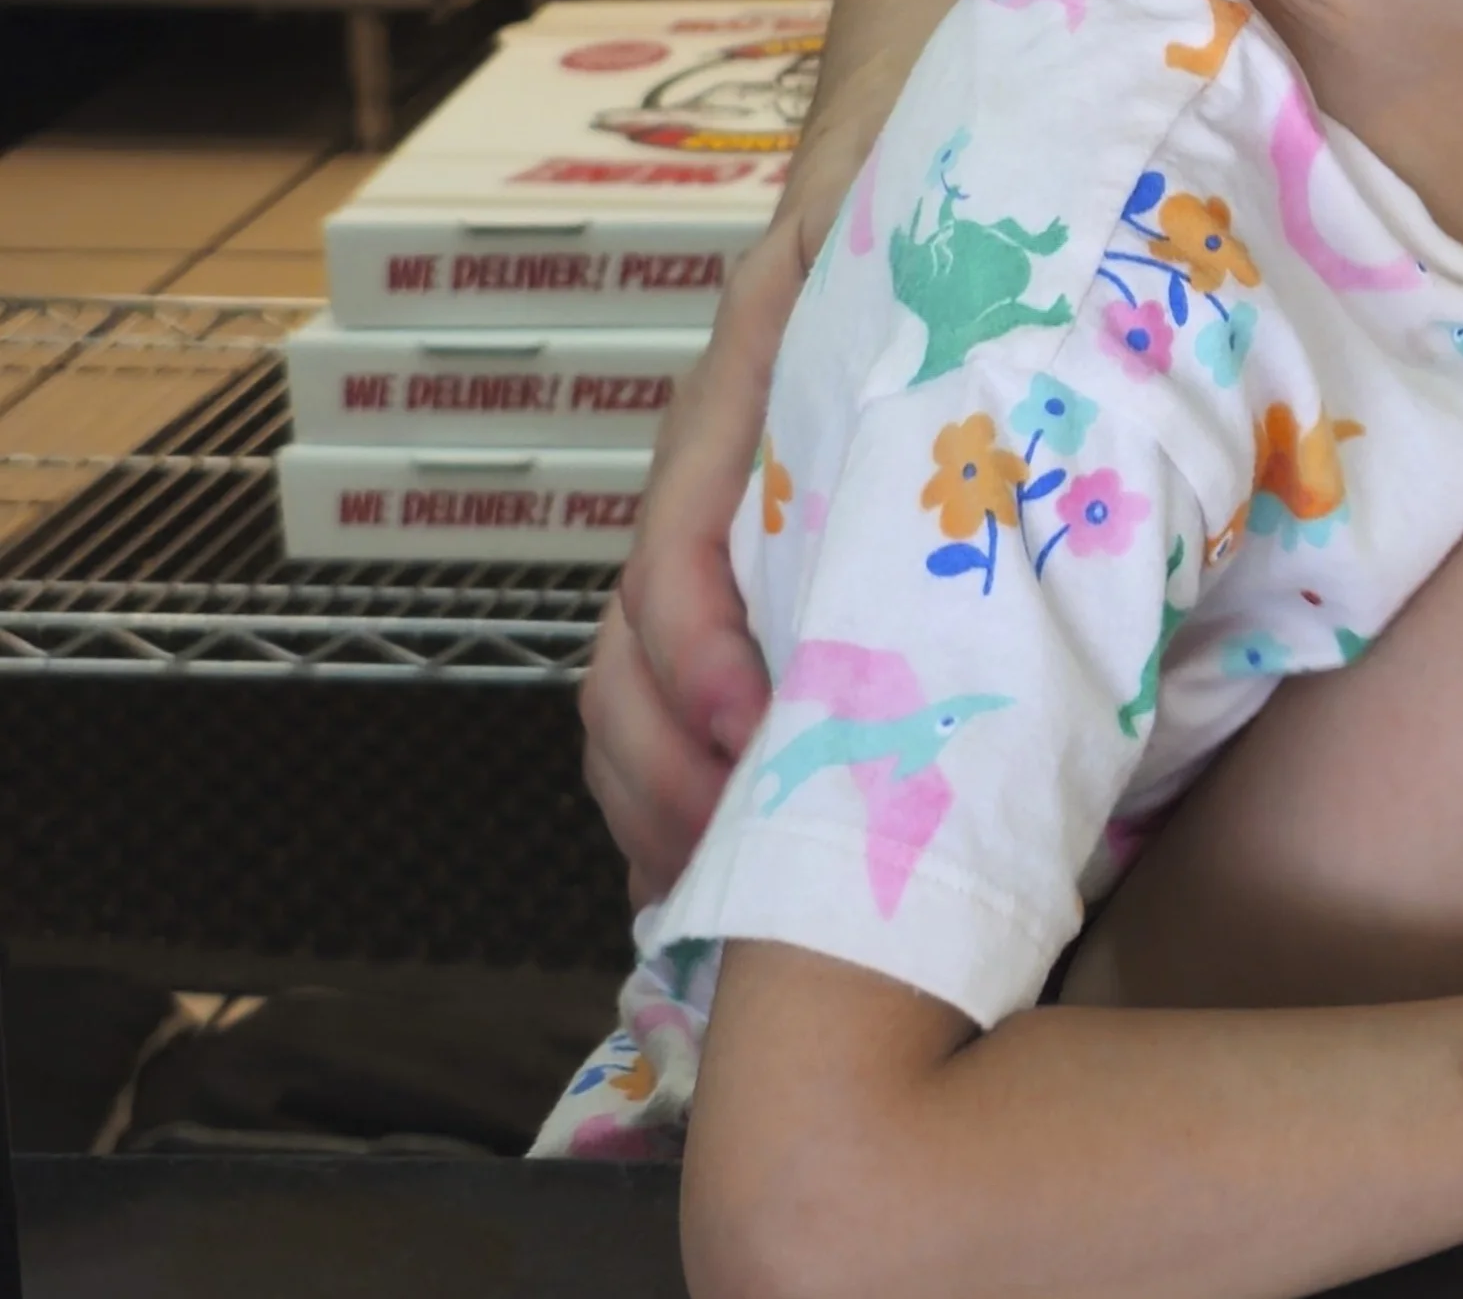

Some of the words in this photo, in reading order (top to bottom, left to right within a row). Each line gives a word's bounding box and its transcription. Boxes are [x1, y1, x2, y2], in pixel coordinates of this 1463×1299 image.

[386, 253, 443, 293] WE
[451, 252, 611, 292] DELIVER!
[617, 252, 725, 291] PIZZA
[341, 372, 396, 413] WE
[404, 372, 563, 414] DELIVER!
[569, 374, 675, 413] PIZZA
[337, 489, 392, 528] WE
[400, 489, 555, 529] DELIVER!
